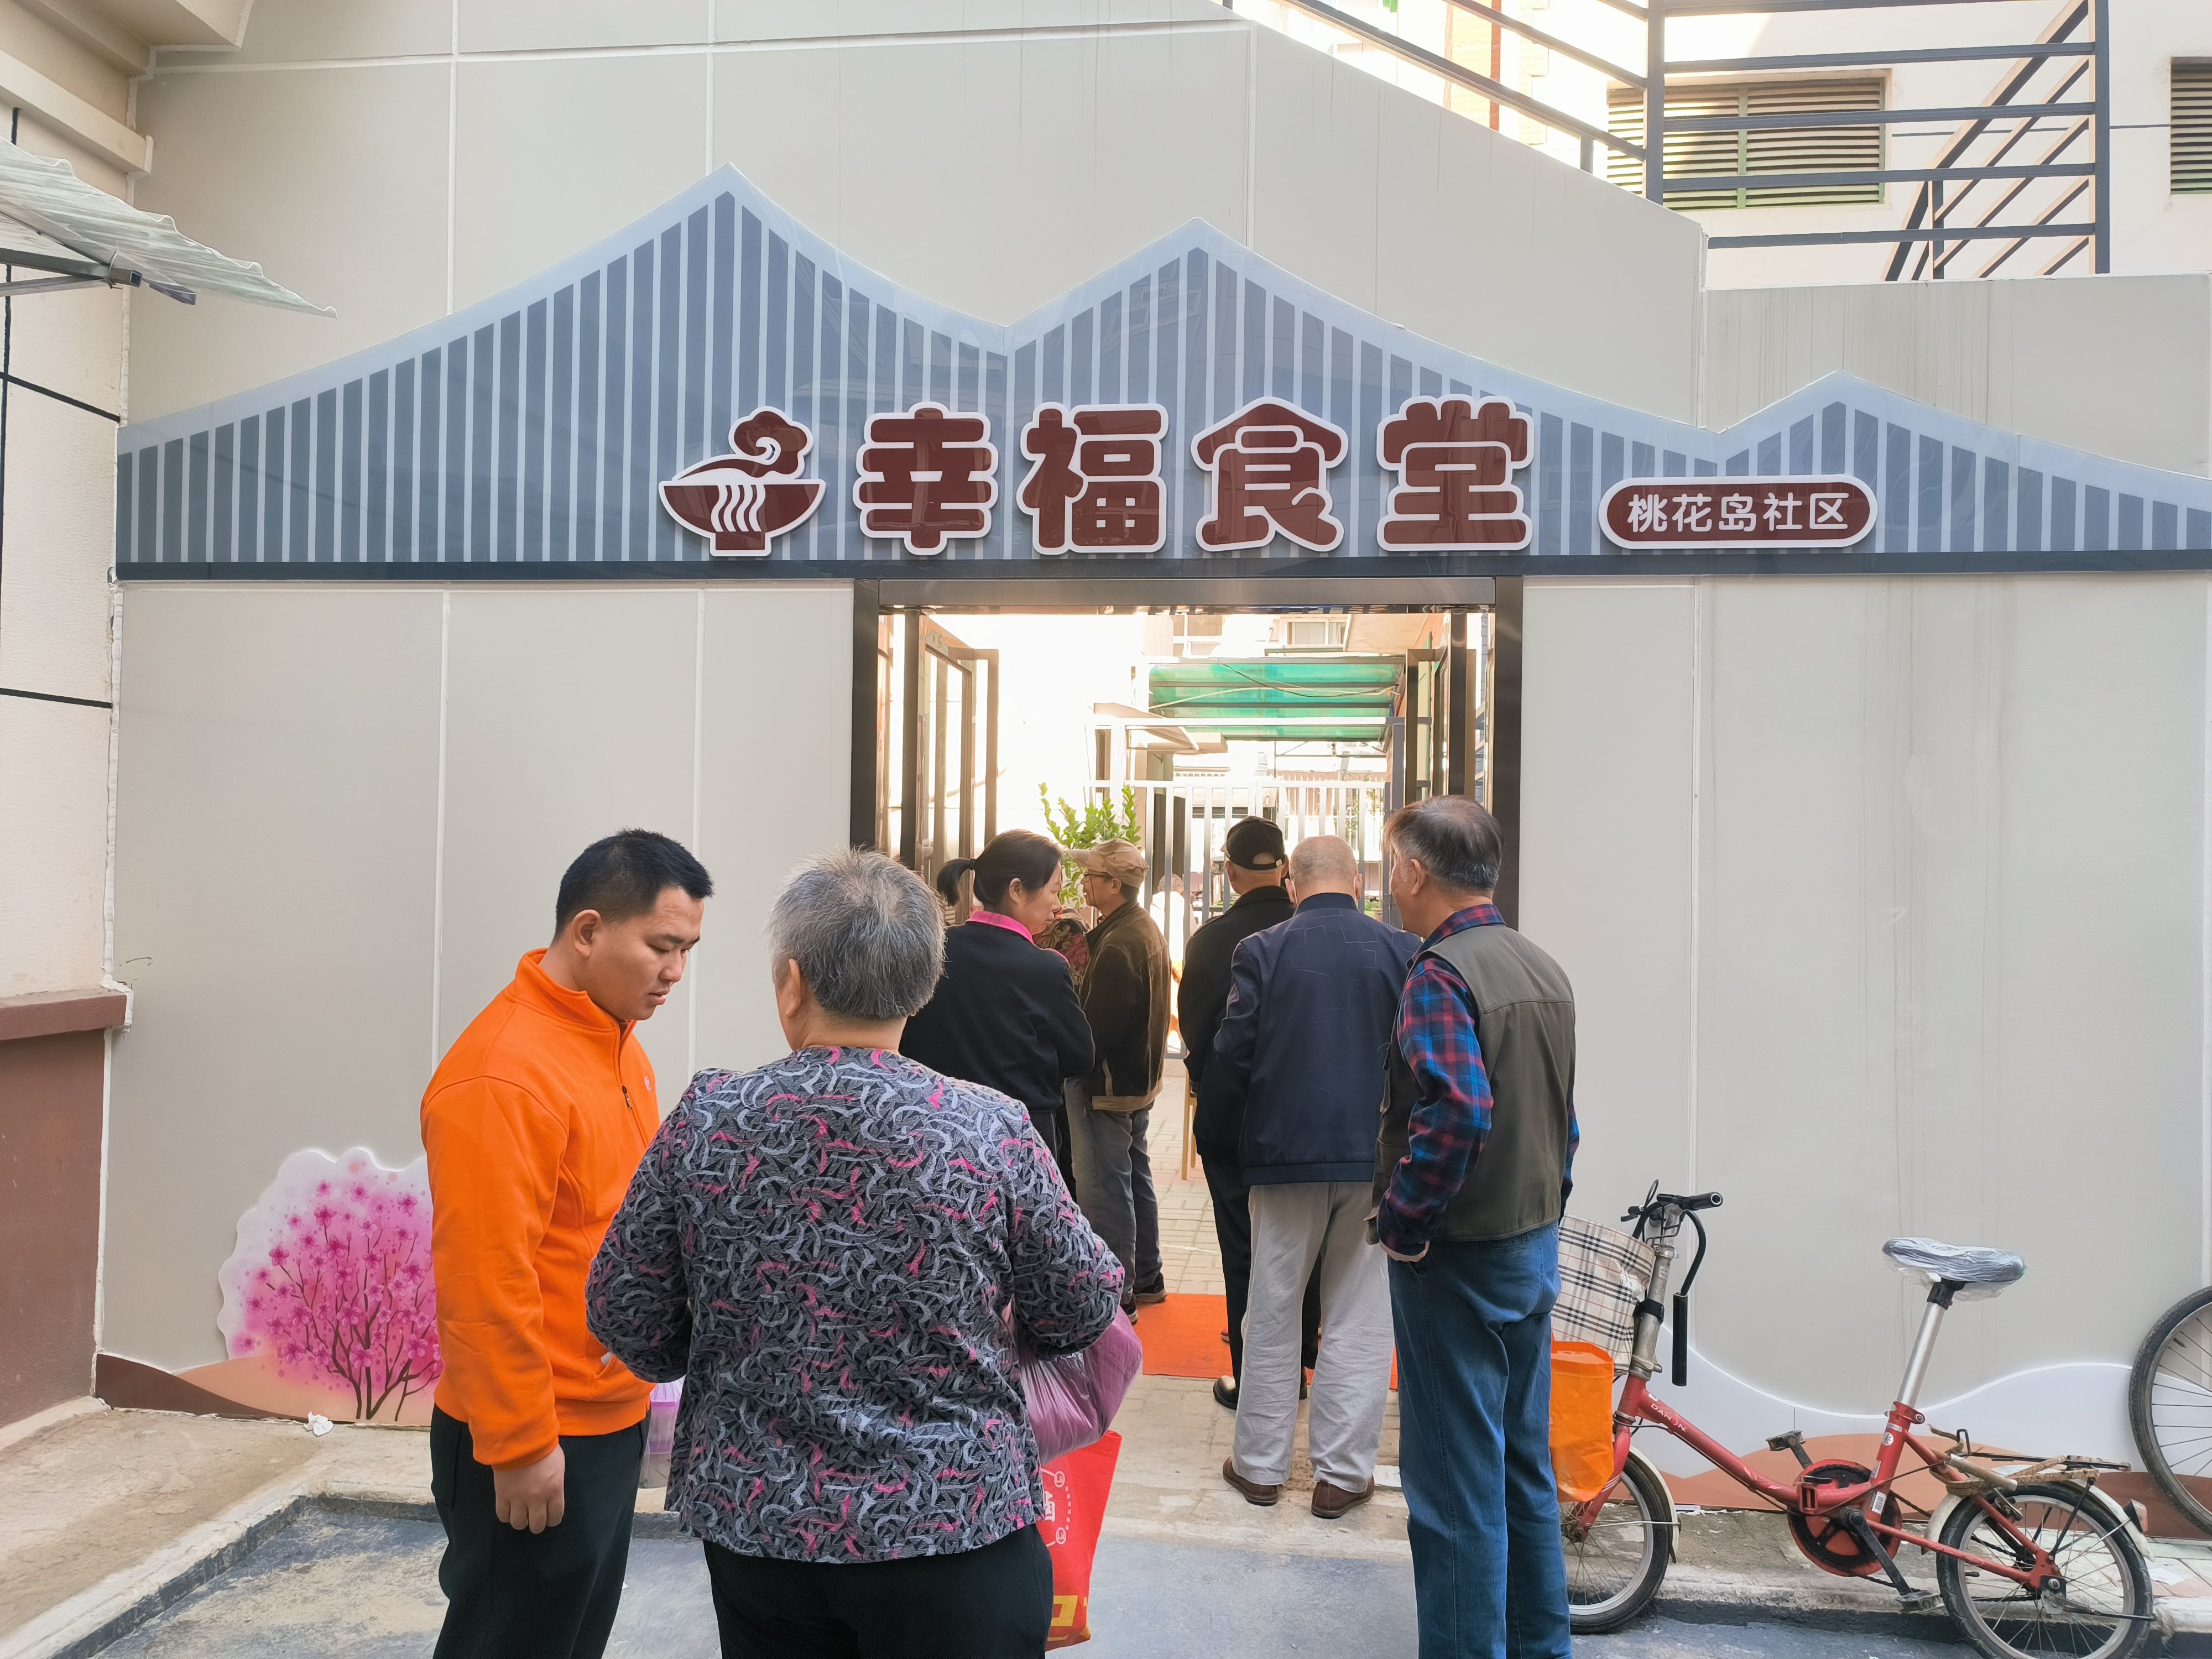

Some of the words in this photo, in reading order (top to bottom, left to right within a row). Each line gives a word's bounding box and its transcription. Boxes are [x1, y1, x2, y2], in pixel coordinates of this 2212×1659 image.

[858, 399, 1531, 551] 幸福食堂
[1627, 492, 1850, 533] 桃花岛社区
